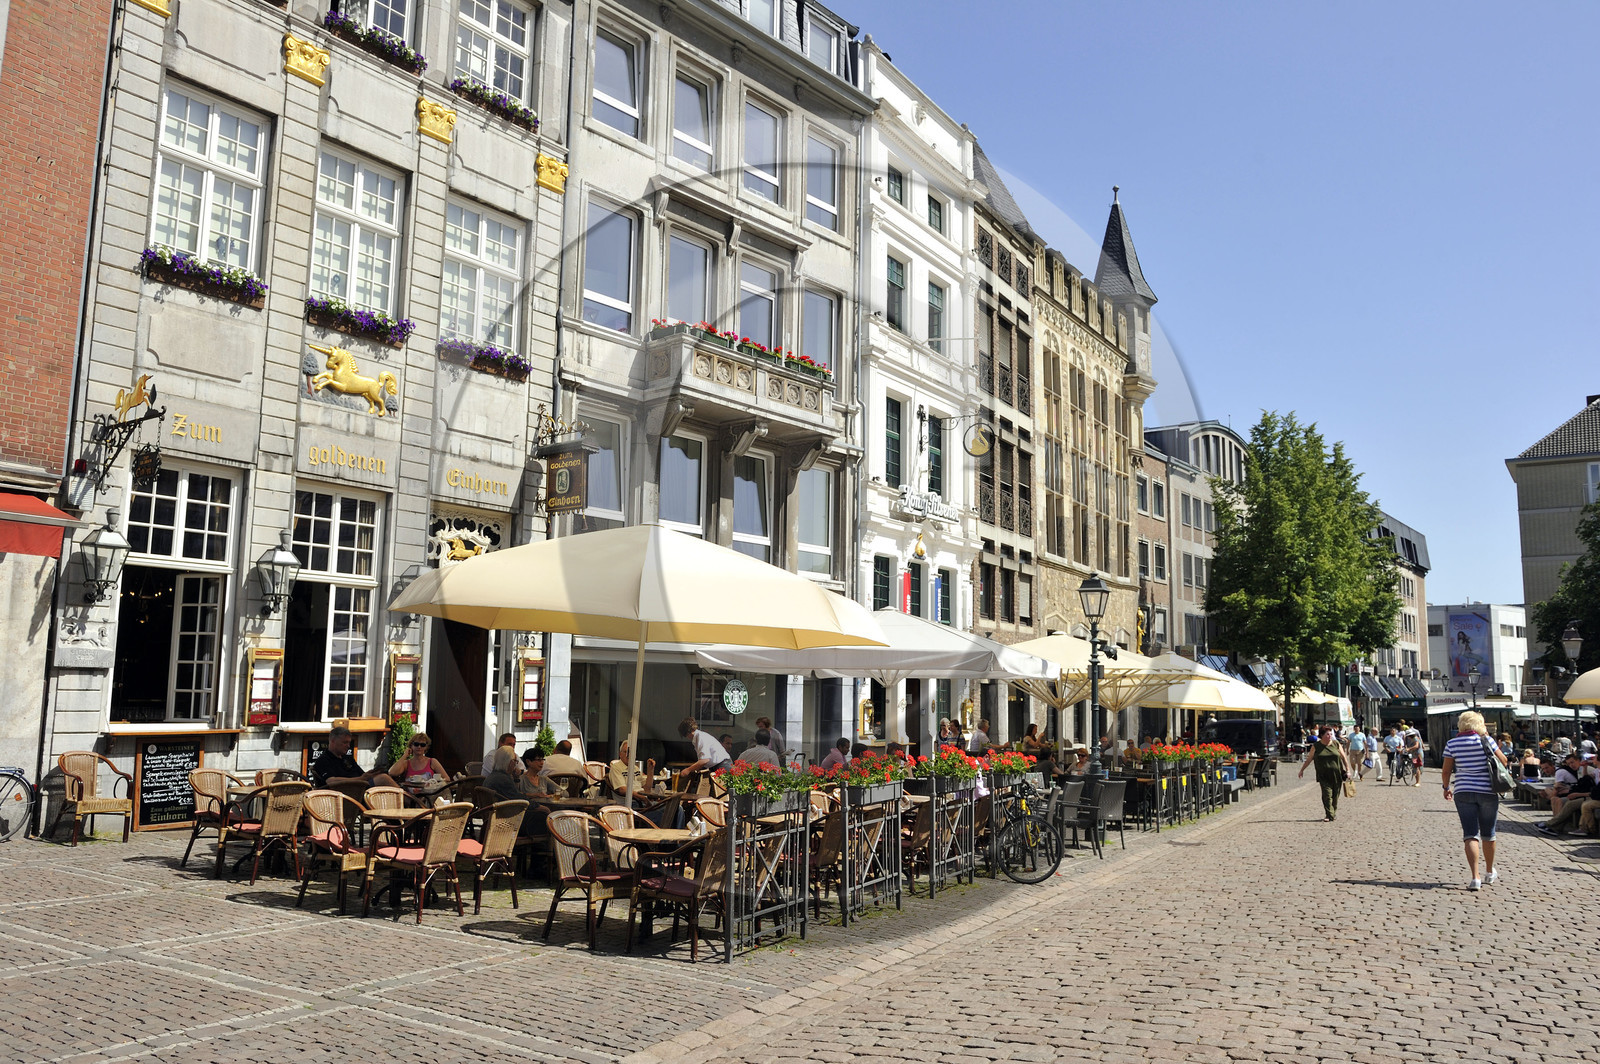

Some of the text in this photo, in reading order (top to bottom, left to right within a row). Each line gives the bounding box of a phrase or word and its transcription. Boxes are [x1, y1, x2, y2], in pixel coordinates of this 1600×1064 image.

[171, 412, 223, 444] Zum
[309, 444, 387, 475] goldenen
[446, 468, 508, 497] Einhorn
[548, 494, 581, 508] Einhorn
[1453, 621, 1474, 631] Sale
[524, 635, 536, 648] 33
[150, 812, 187, 822] Einhorn
